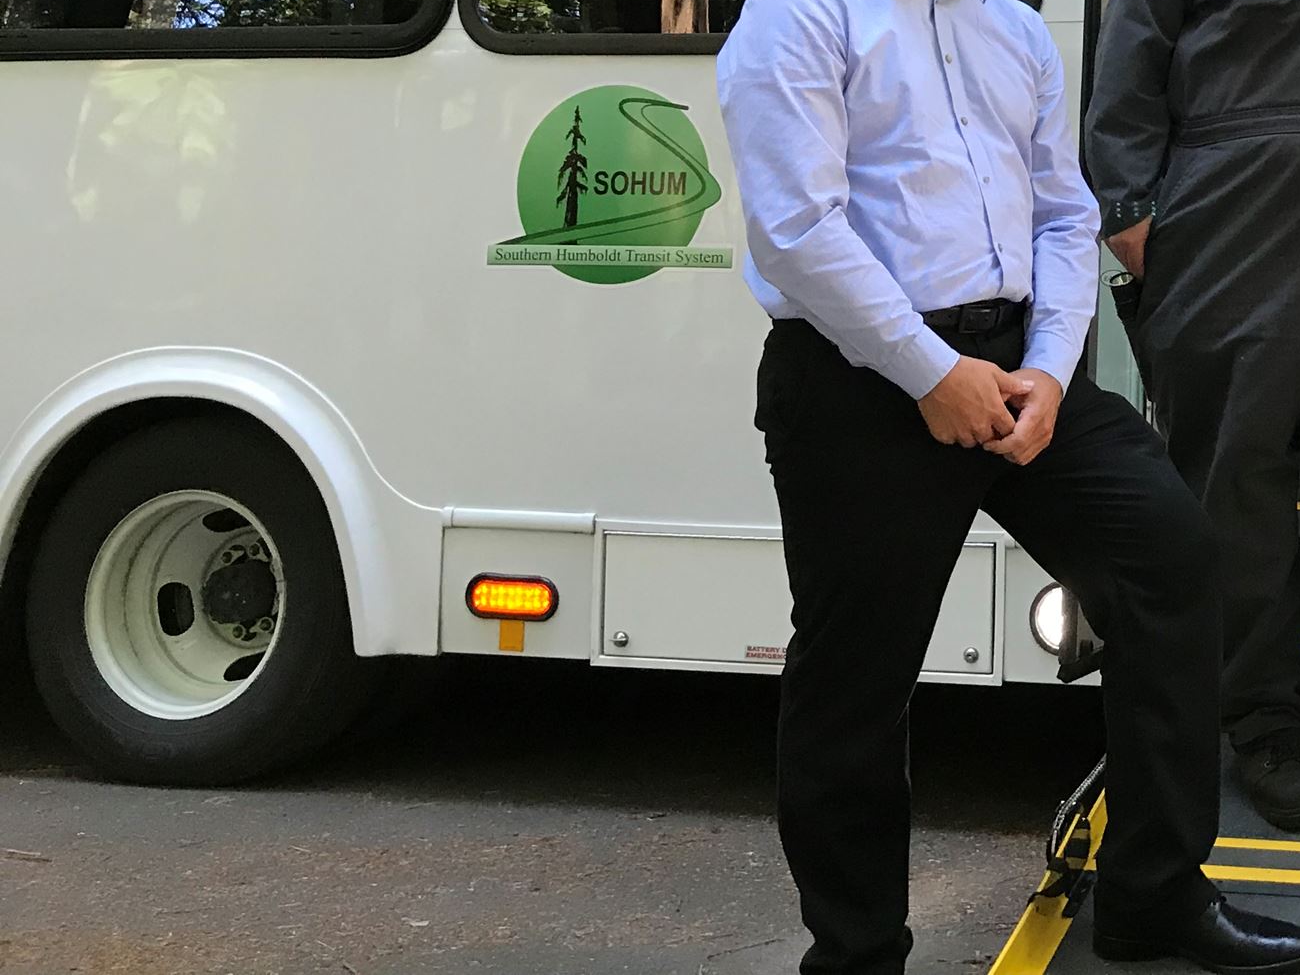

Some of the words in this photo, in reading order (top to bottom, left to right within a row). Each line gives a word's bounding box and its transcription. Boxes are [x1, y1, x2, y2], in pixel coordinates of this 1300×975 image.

[593, 171, 687, 196] SOHUM
[494, 248, 552, 262] Southern
[556, 248, 622, 263] Humboldt
[625, 249, 671, 263] Transit
[675, 250, 724, 266] System
